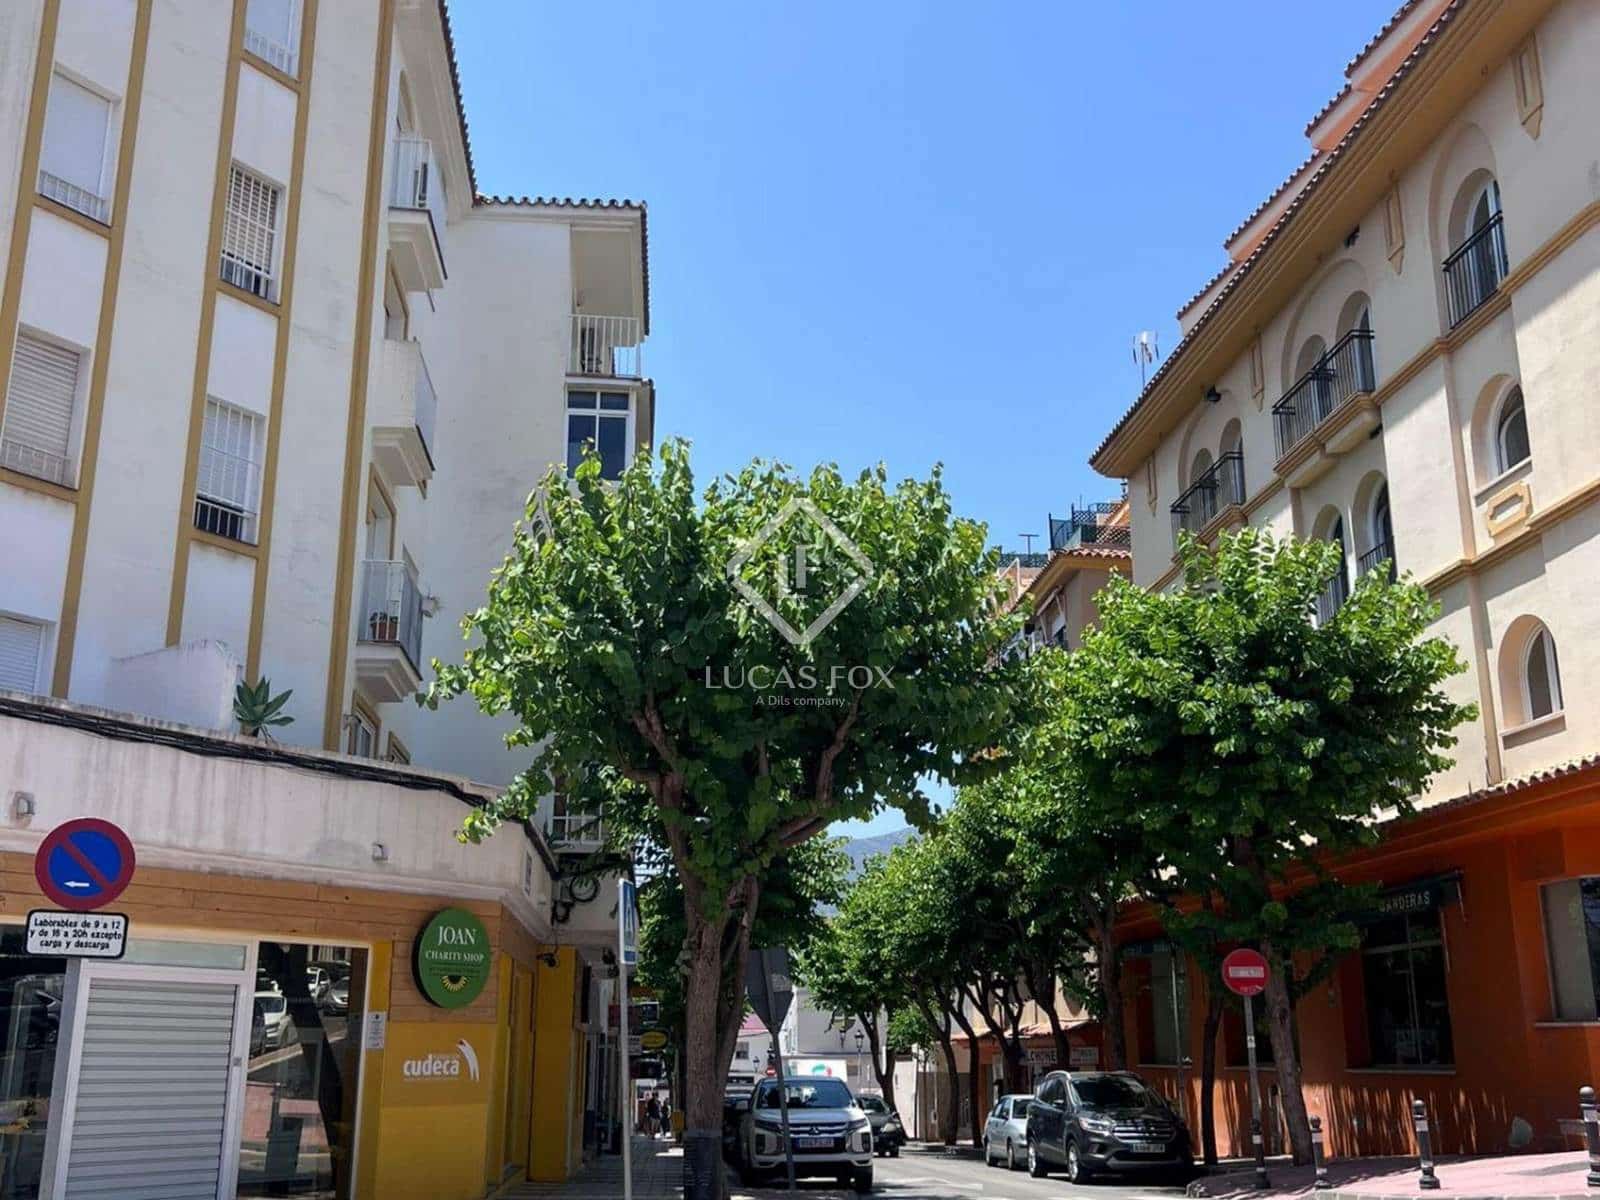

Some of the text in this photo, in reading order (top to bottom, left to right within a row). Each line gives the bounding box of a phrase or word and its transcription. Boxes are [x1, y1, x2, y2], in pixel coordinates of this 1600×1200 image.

[34, 918, 78, 928] Laborables
[81, 920, 91, 929] de
[94, 920, 100, 929] 9
[111, 921, 121, 929] 12
[29, 929, 35, 938] y
[38, 929, 48, 937] de
[72, 929, 88, 938] 20h
[91, 930, 122, 941] excepto
[437, 926, 477, 946] JOAN
[40, 940, 109, 950] carga y descarga
[425, 950, 485, 964] CHARITY SHOP
[403, 1053, 460, 1076] cudeca
